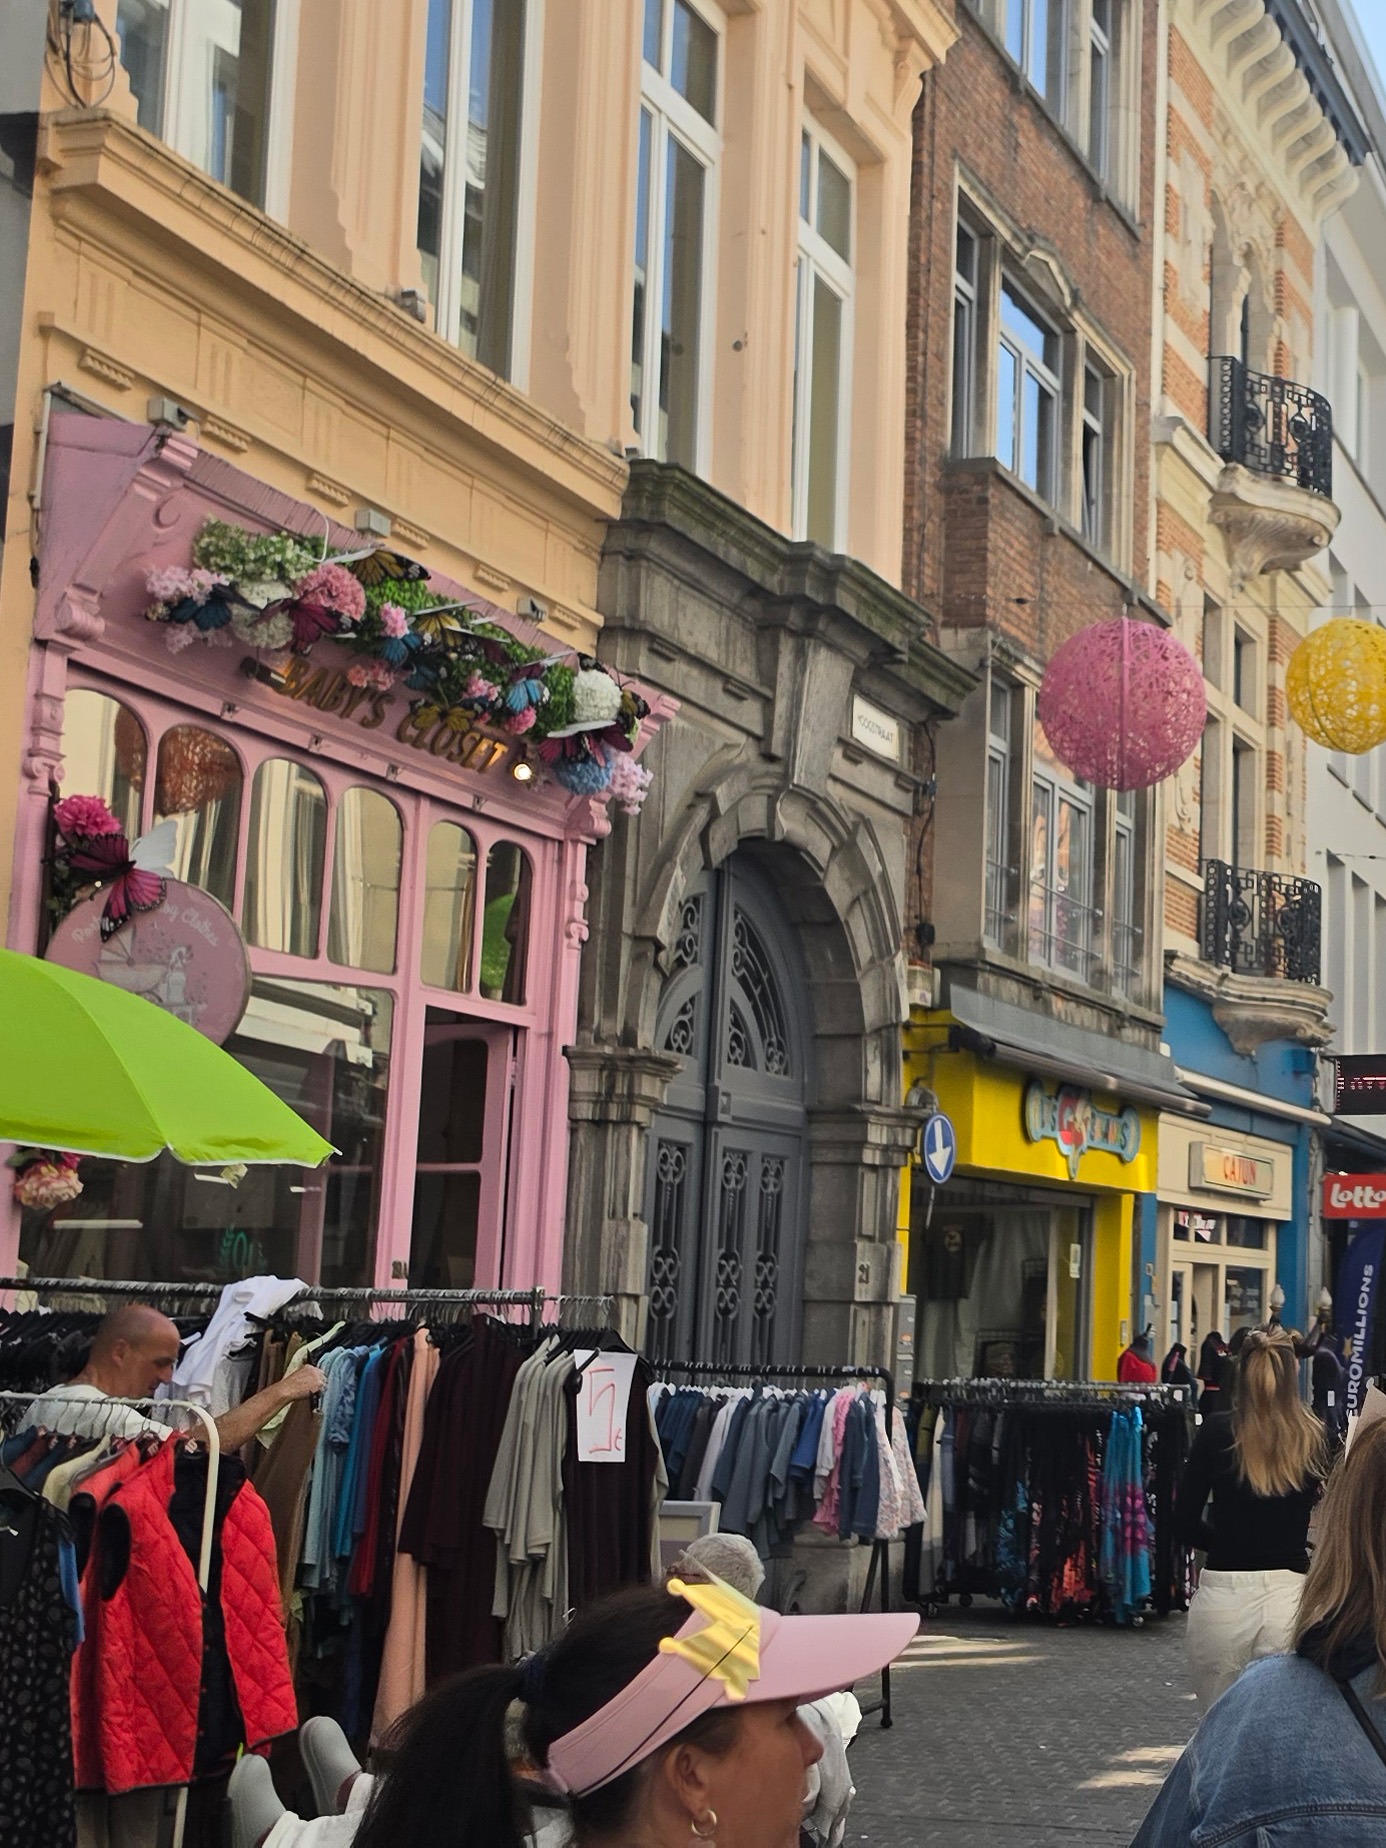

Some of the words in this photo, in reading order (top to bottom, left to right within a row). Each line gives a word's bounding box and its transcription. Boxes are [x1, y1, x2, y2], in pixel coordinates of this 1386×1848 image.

[276, 656, 394, 730] BABY'S
[397, 711, 509, 773] CLOSET
[1223, 1154, 1257, 1187] CAJUN
